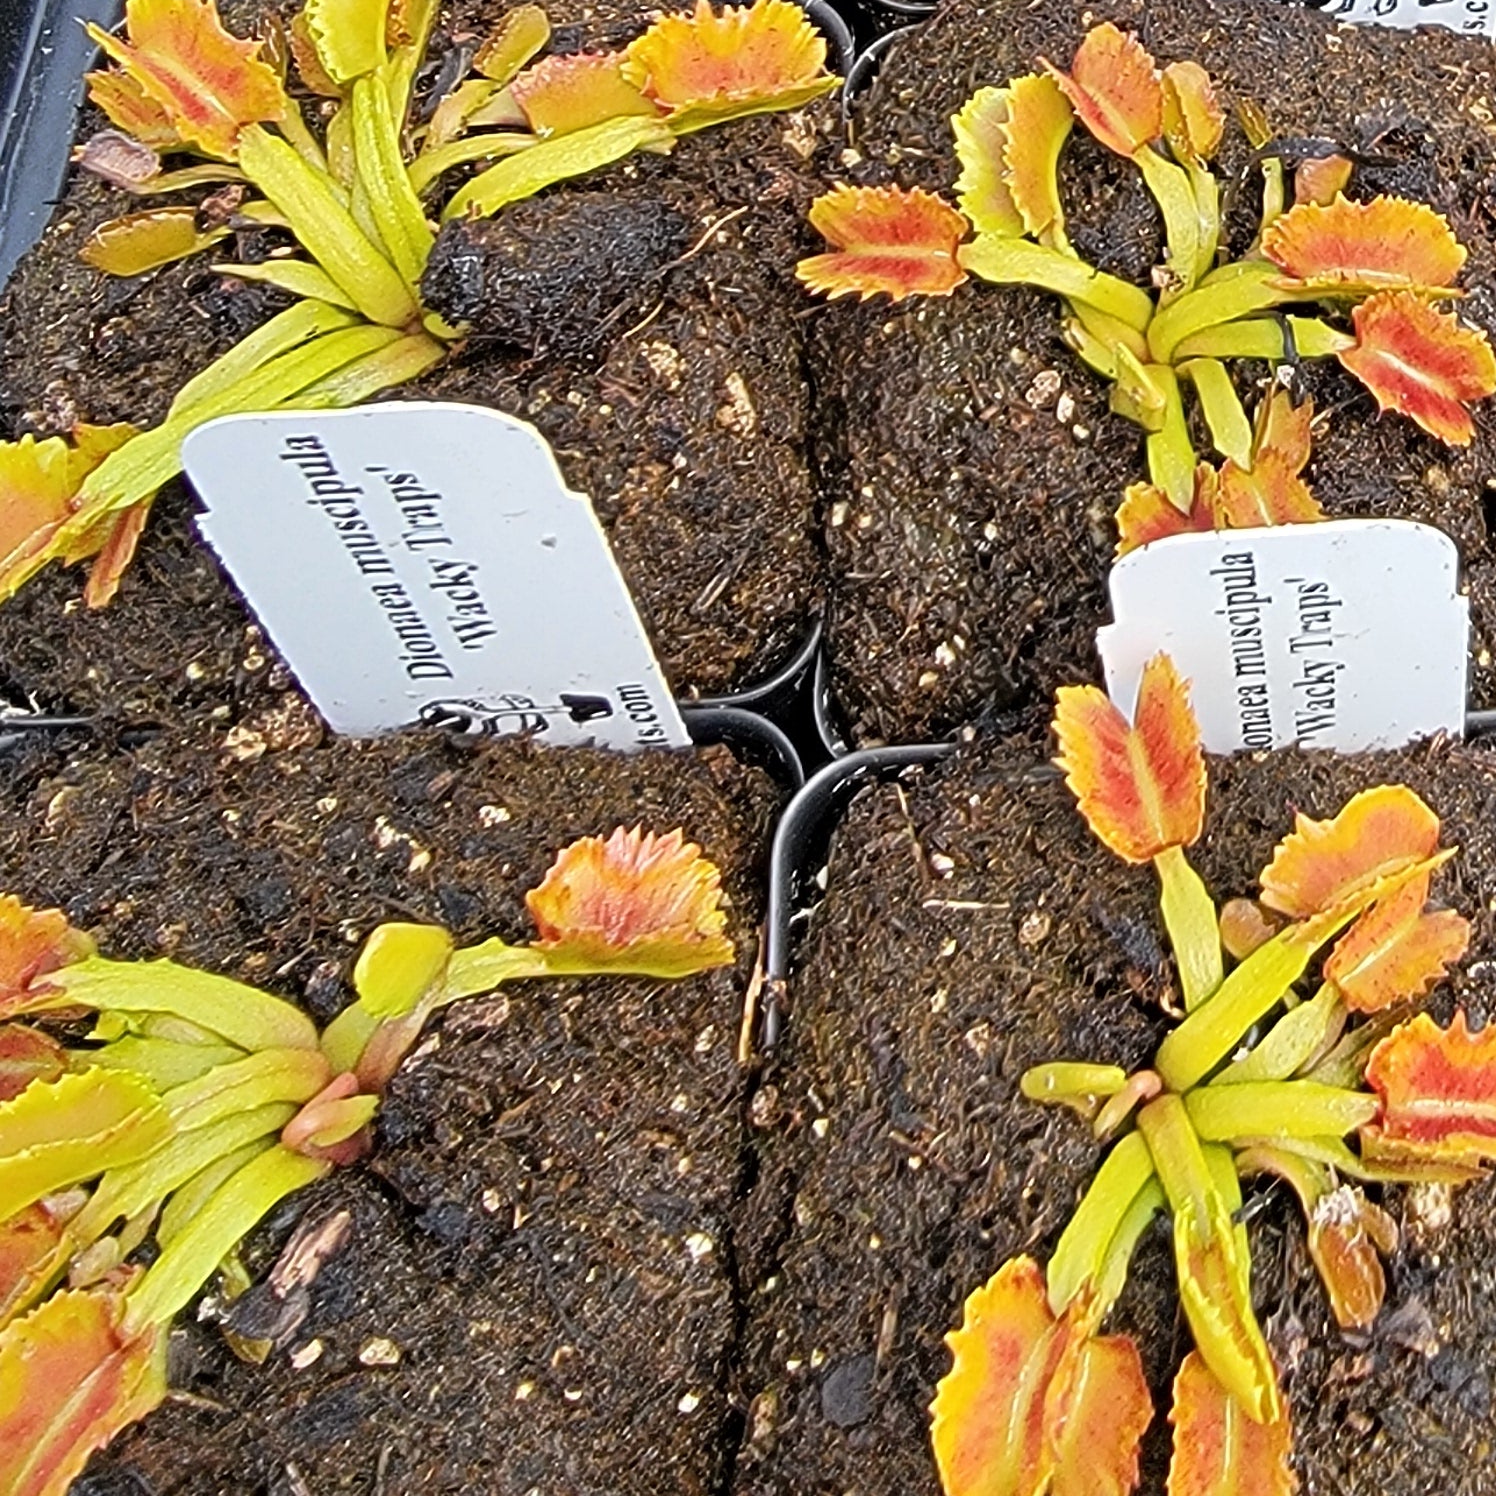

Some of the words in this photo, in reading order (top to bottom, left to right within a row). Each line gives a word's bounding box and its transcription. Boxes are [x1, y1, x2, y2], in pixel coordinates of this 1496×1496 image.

[279, 435, 394, 575] muscipula
[365, 466, 453, 552] Traps'
[371, 583, 454, 682] Dionaea
[428, 557, 498, 650] 'Wacky
[1209, 551, 1272, 679] muscipula
[1284, 579, 1343, 654] Traps'
[1236, 683, 1273, 747] onaea
[1292, 660, 1346, 741] 'Wacky
